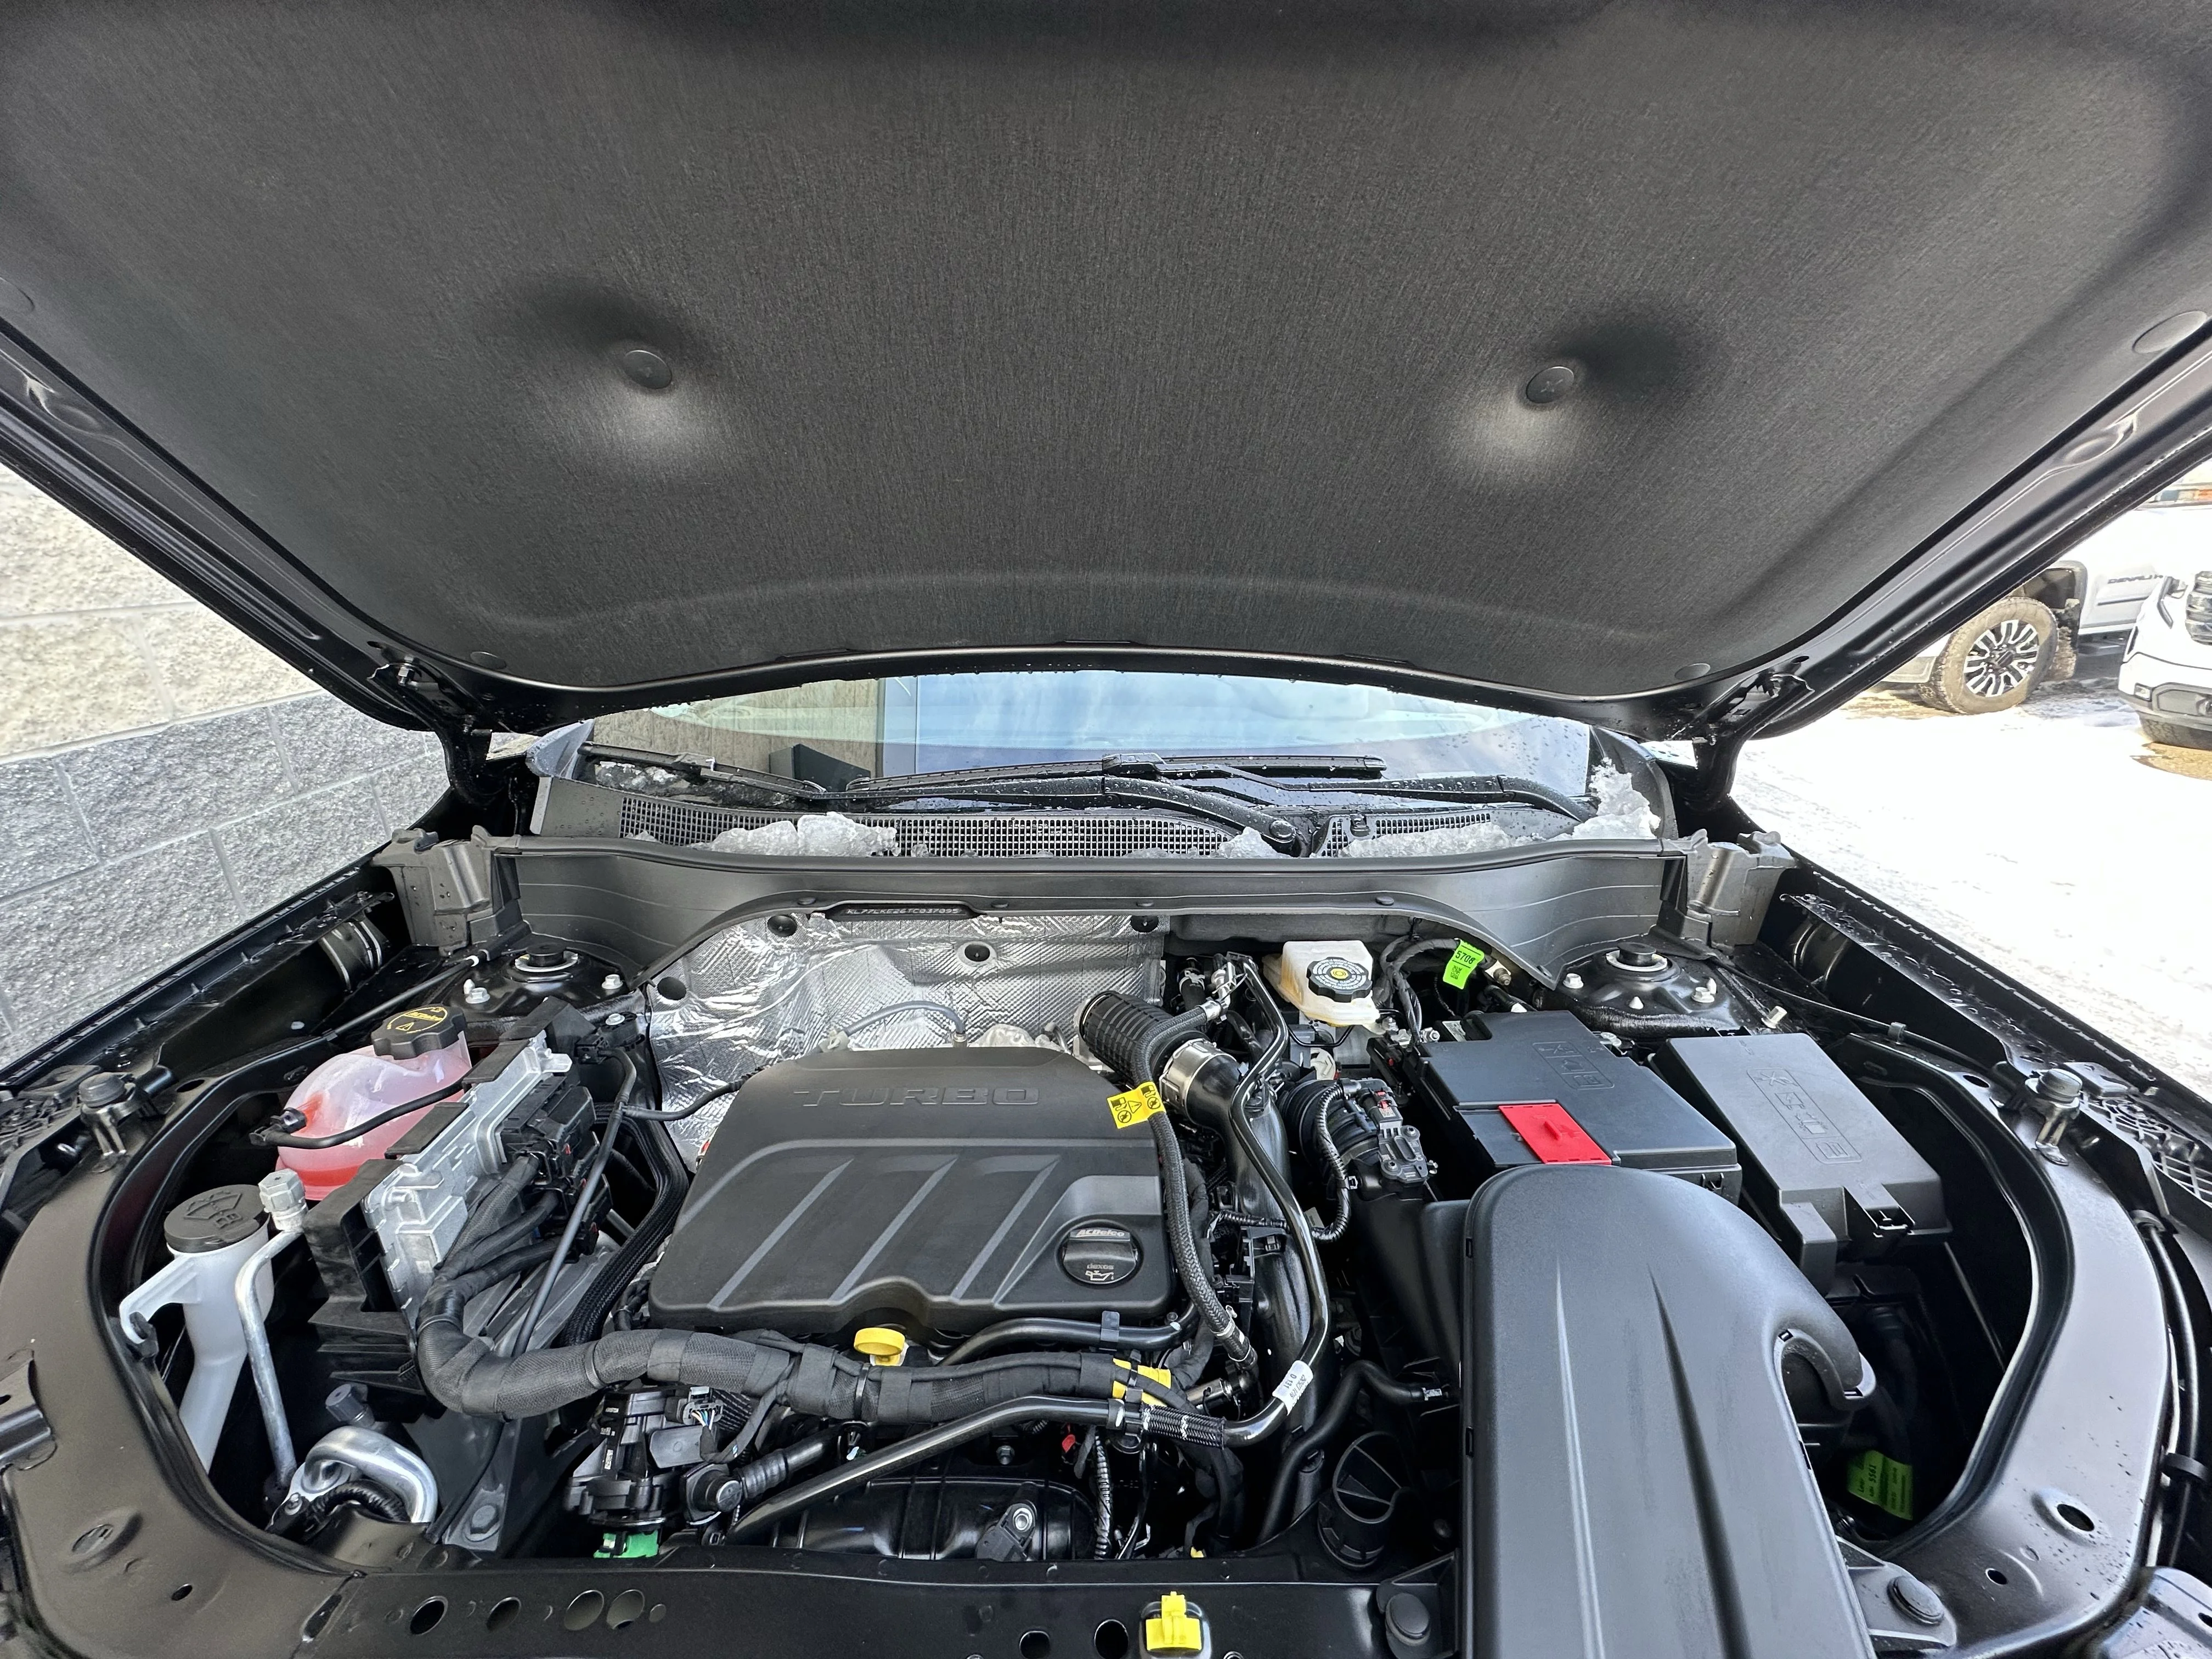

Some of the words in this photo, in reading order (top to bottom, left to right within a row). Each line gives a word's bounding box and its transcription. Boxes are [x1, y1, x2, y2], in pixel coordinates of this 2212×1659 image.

[1455, 950, 1476, 964] 5708
[793, 1087, 1040, 1106] TURBO
[1076, 1229, 1125, 1237] ACDelco
